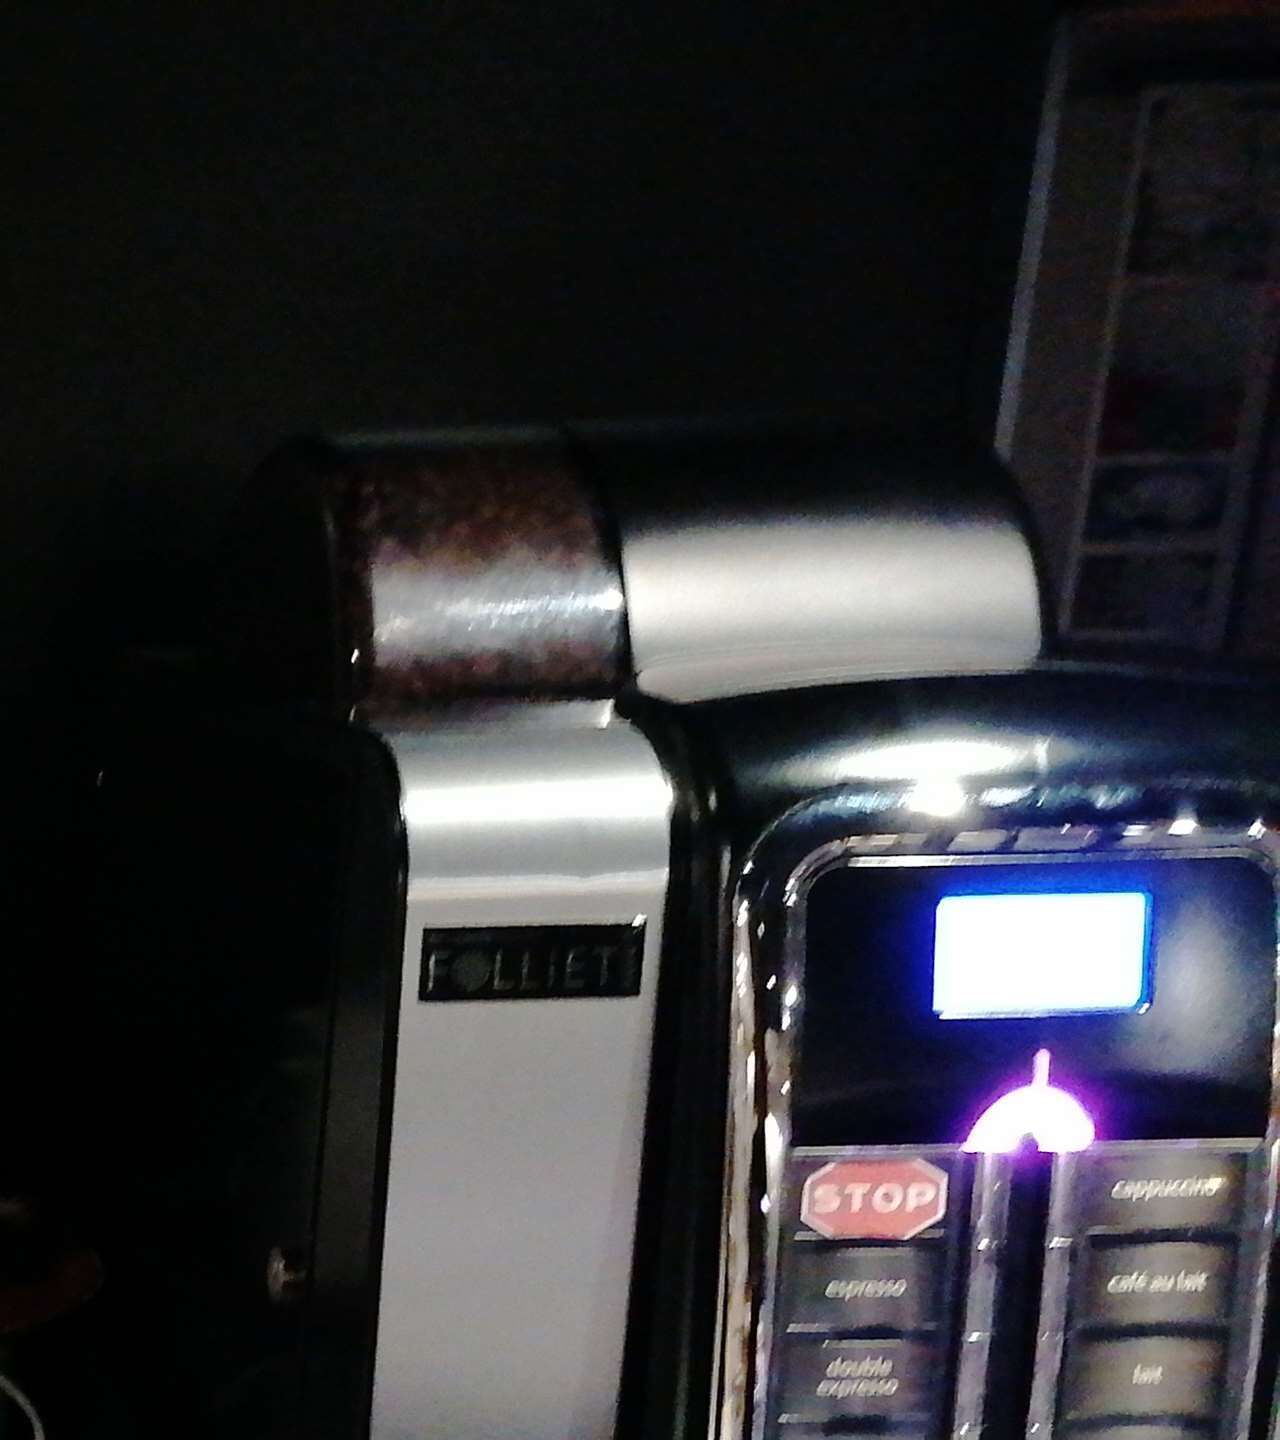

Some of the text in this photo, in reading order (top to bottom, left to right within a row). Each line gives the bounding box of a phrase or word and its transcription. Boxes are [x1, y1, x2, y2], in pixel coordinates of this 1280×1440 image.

[813, 1182, 937, 1215] STOP
[1111, 1175, 1224, 1202] cappuccino
[824, 1279, 908, 1301] espresso
[1107, 1269, 1209, 1293] café au lait
[825, 1355, 894, 1378] double
[1132, 1363, 1164, 1385] lait
[816, 1378, 900, 1400] espresso
